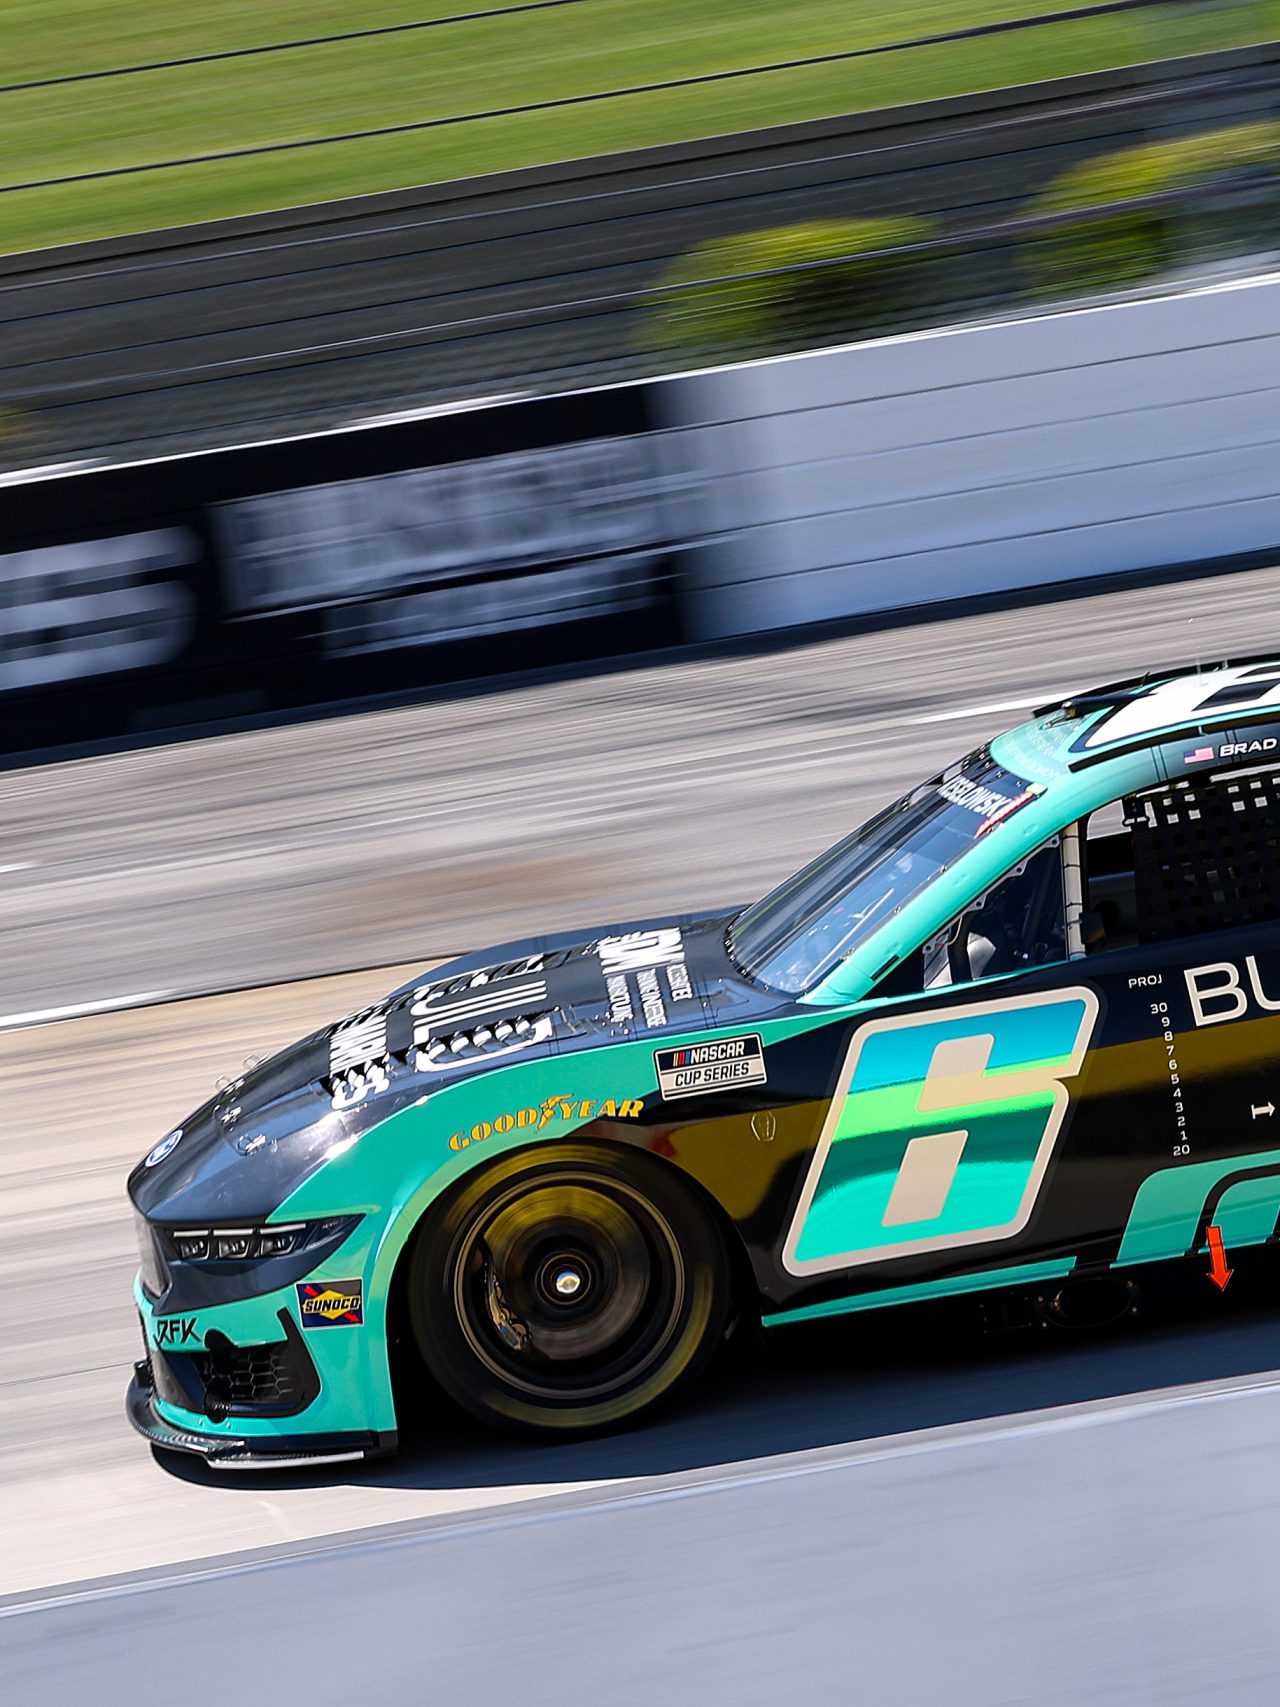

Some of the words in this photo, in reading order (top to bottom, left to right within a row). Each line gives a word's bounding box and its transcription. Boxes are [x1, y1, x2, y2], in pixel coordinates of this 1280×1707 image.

[1219, 738, 1277, 758] BRAD
[1128, 974, 1163, 989] PROJ
[1150, 1002, 1168, 1014] 30
[1161, 1017, 1170, 1027] 9
[1164, 1031, 1173, 1041] 8
[691, 1041, 744, 1065] NASCAR
[1166, 1045, 1174, 1056] 7
[1168, 1059, 1178, 1071] 6
[675, 1068, 701, 1087] CUP
[704, 1062, 750, 1082] SERIES
[1171, 1073, 1180, 1085] 5
[1173, 1088, 1182, 1098] 4
[1175, 1102, 1184, 1113] 3
[449, 1099, 644, 1151] GOODYEAR
[1177, 1116, 1186, 1127] 2
[782, 986, 1100, 1278] 6
[1180, 1130, 1188, 1141] 1
[1173, 1144, 1190, 1157] 20
[304, 1296, 360, 1313] SUNOCO
[156, 1317, 203, 1344] RFK
